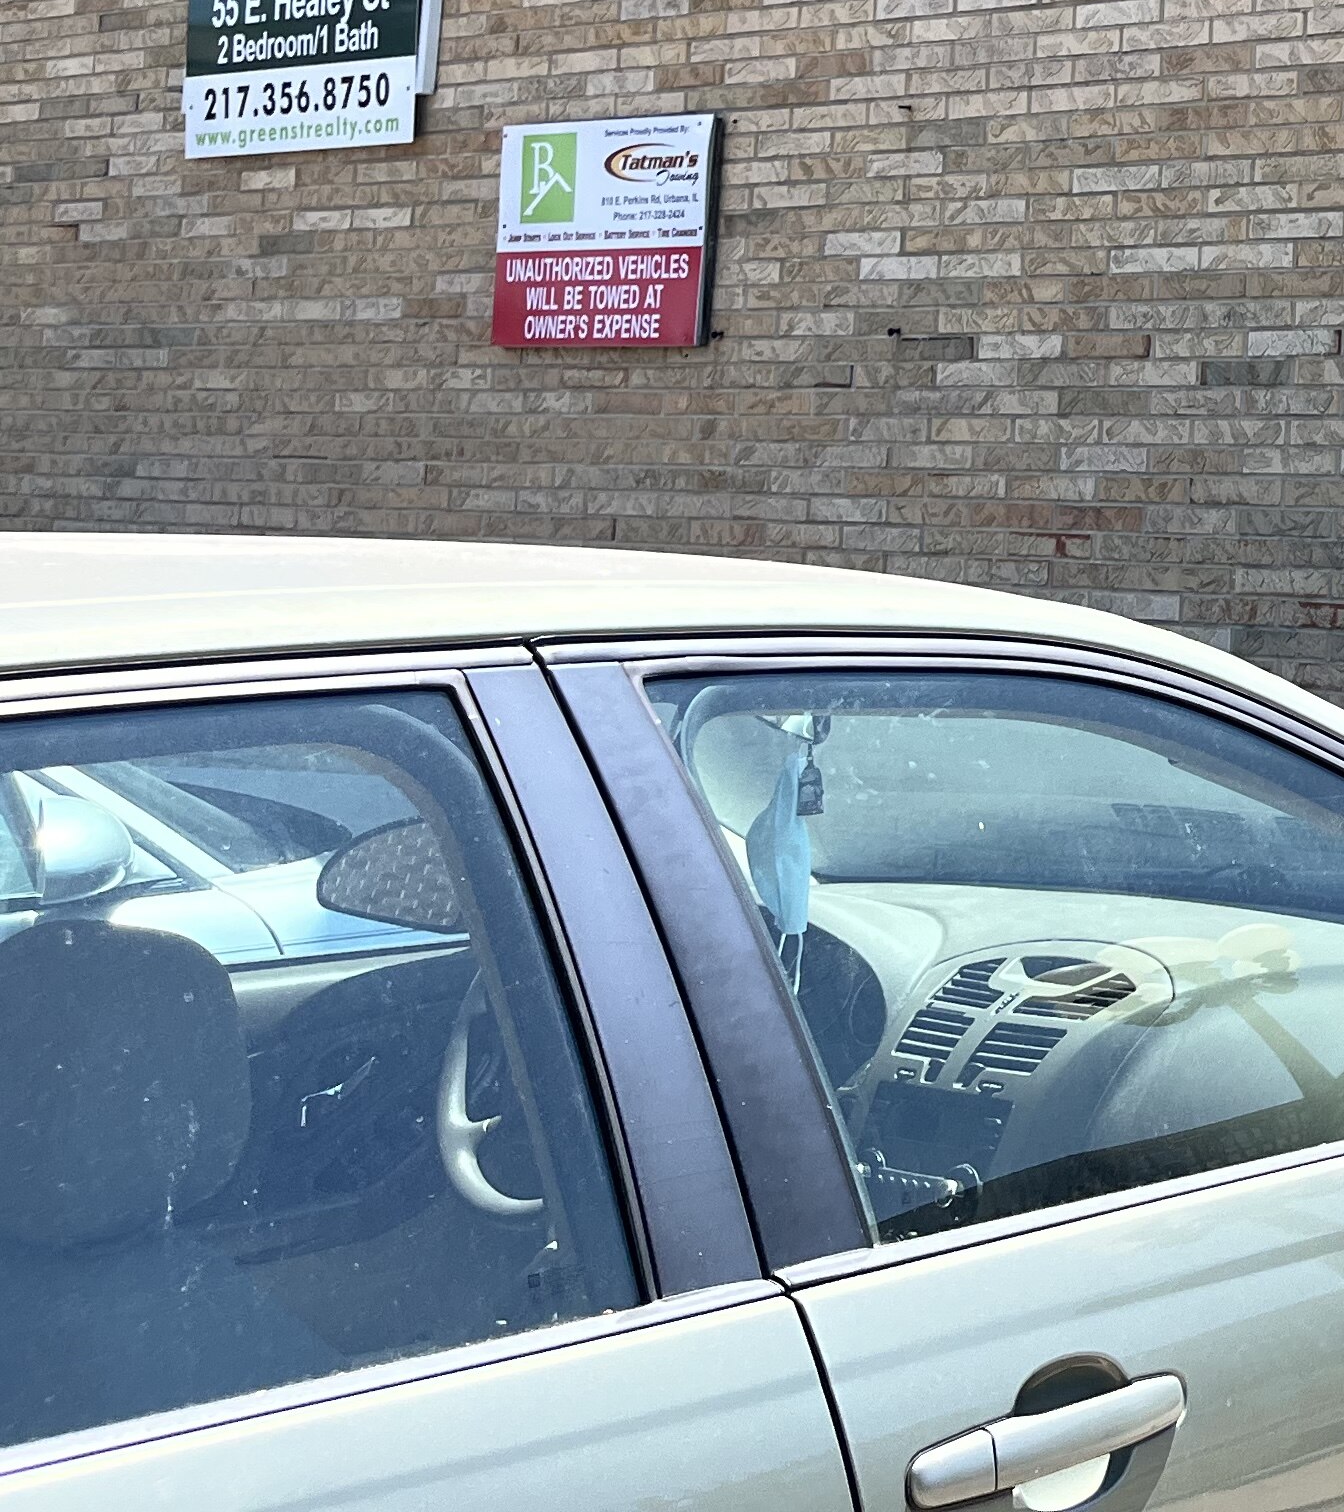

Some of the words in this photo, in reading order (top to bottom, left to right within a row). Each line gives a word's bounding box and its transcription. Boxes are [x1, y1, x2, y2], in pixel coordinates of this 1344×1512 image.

[217, 35, 229, 65] 2
[232, 24, 329, 63] Bedroom/1
[334, 19, 379, 53] Bath
[203, 72, 390, 121] 217.356.8750
[195, 116, 399, 148] www.greenstrealty.com
[621, 150, 699, 171] Tatman's
[506, 256, 613, 282] UNAUTHORIZED
[618, 253, 690, 280] VEHICLES
[526, 286, 558, 310] WILL
[563, 285, 583, 310] BE
[588, 284, 640, 310] TOWED
[643, 284, 664, 309] AT
[524, 314, 589, 339] OWNER'S
[593, 313, 661, 338] EXPENSE
